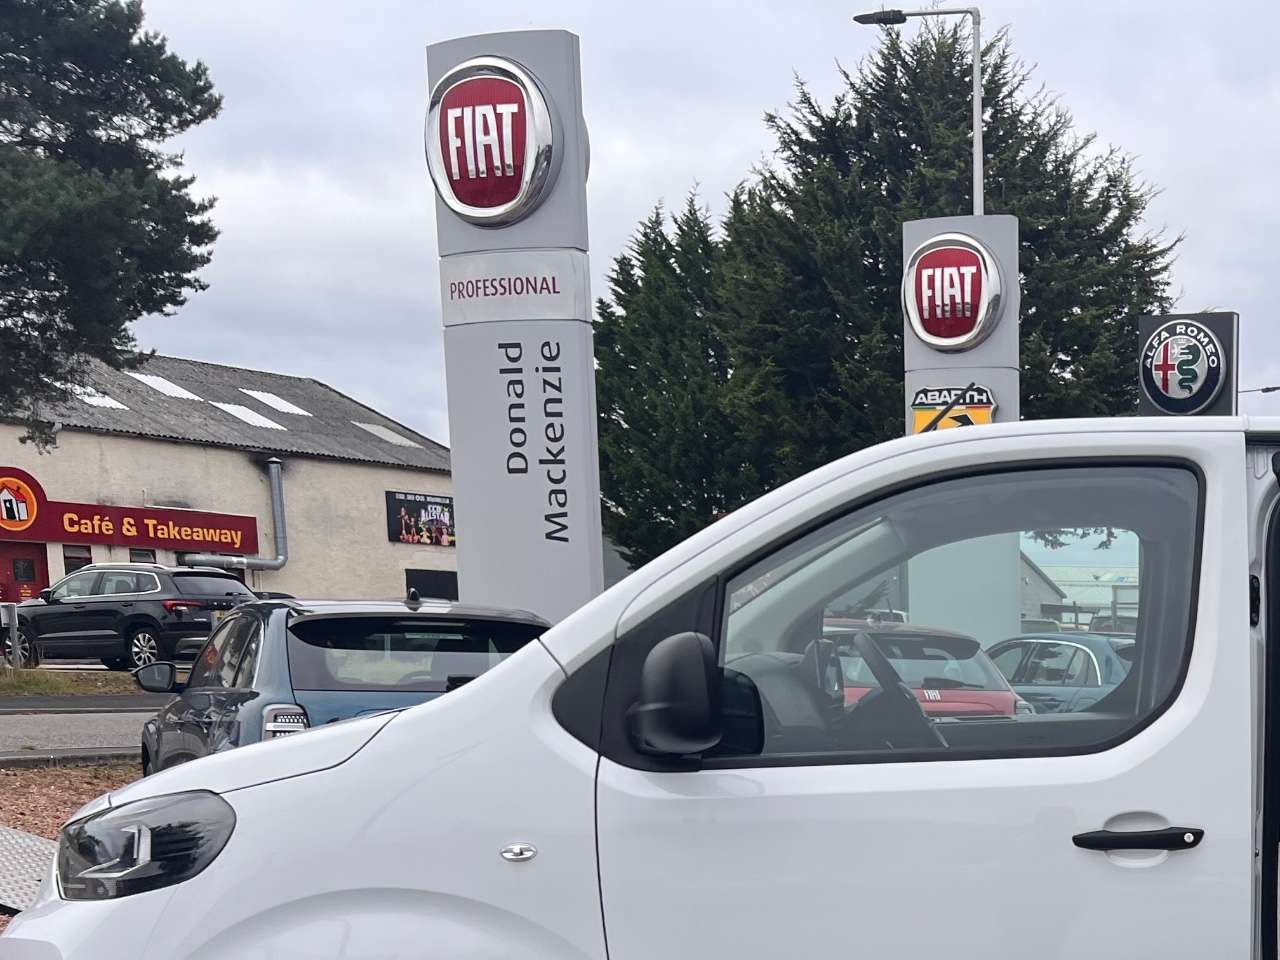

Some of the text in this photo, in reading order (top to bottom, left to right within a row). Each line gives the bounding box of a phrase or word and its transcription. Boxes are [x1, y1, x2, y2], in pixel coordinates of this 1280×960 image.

[447, 103, 518, 180] FIAT
[450, 276, 560, 301] PROFESSIONAL
[921, 265, 977, 319] FIAT
[1144, 325, 1218, 368] ALFA ROMEO
[498, 342, 528, 474] Donald
[535, 341, 569, 542] Mackenzie
[63, 512, 242, 548] Café & Takeaway
